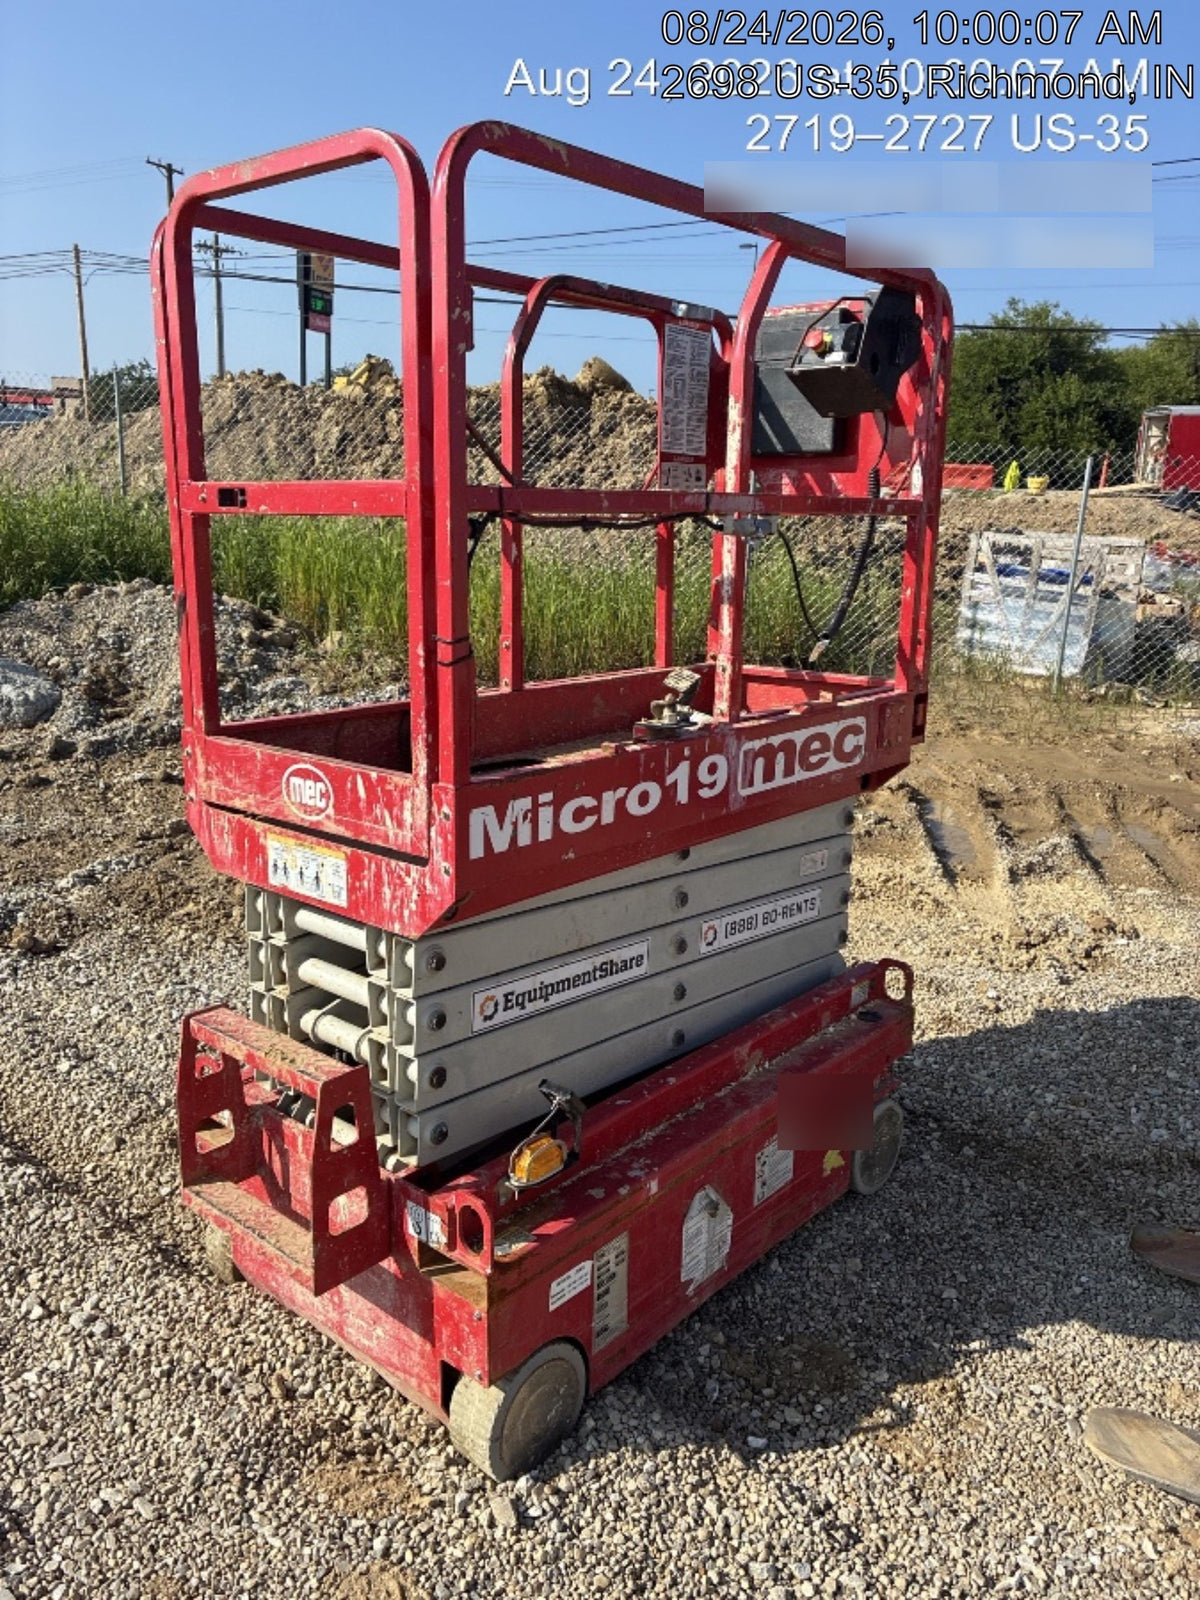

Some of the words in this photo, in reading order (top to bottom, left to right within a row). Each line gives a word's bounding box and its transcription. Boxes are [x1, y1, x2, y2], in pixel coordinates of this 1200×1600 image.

[746, 721, 865, 791] mec
[289, 776, 327, 809] mec
[502, 951, 645, 1013] EquipmentShare
